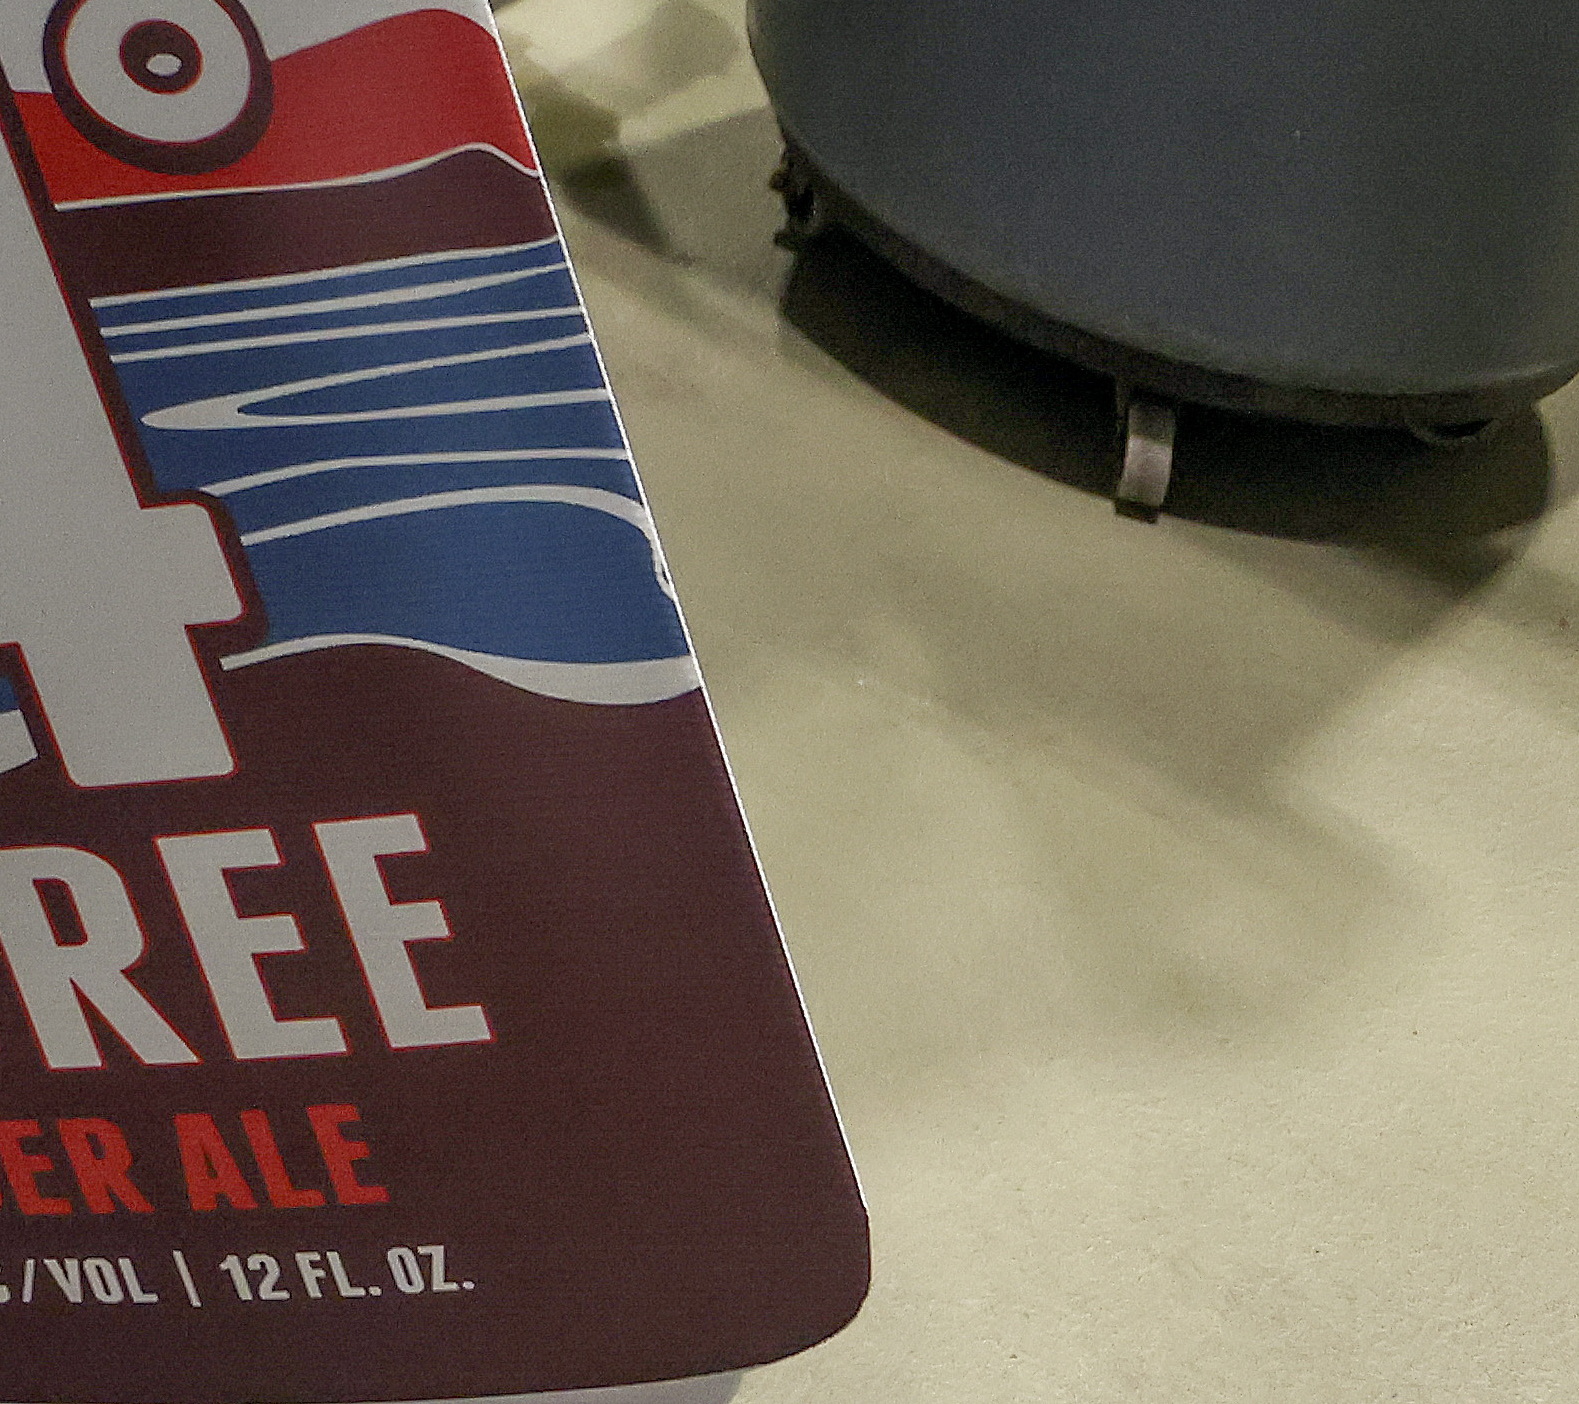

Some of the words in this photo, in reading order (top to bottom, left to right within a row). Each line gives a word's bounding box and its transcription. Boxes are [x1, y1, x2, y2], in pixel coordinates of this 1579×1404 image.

[174, 1102, 392, 1213] ALE
[218, 1253, 292, 1302] 12
[293, 1249, 383, 1298] FL.
[385, 1244, 476, 1295] OZ.
